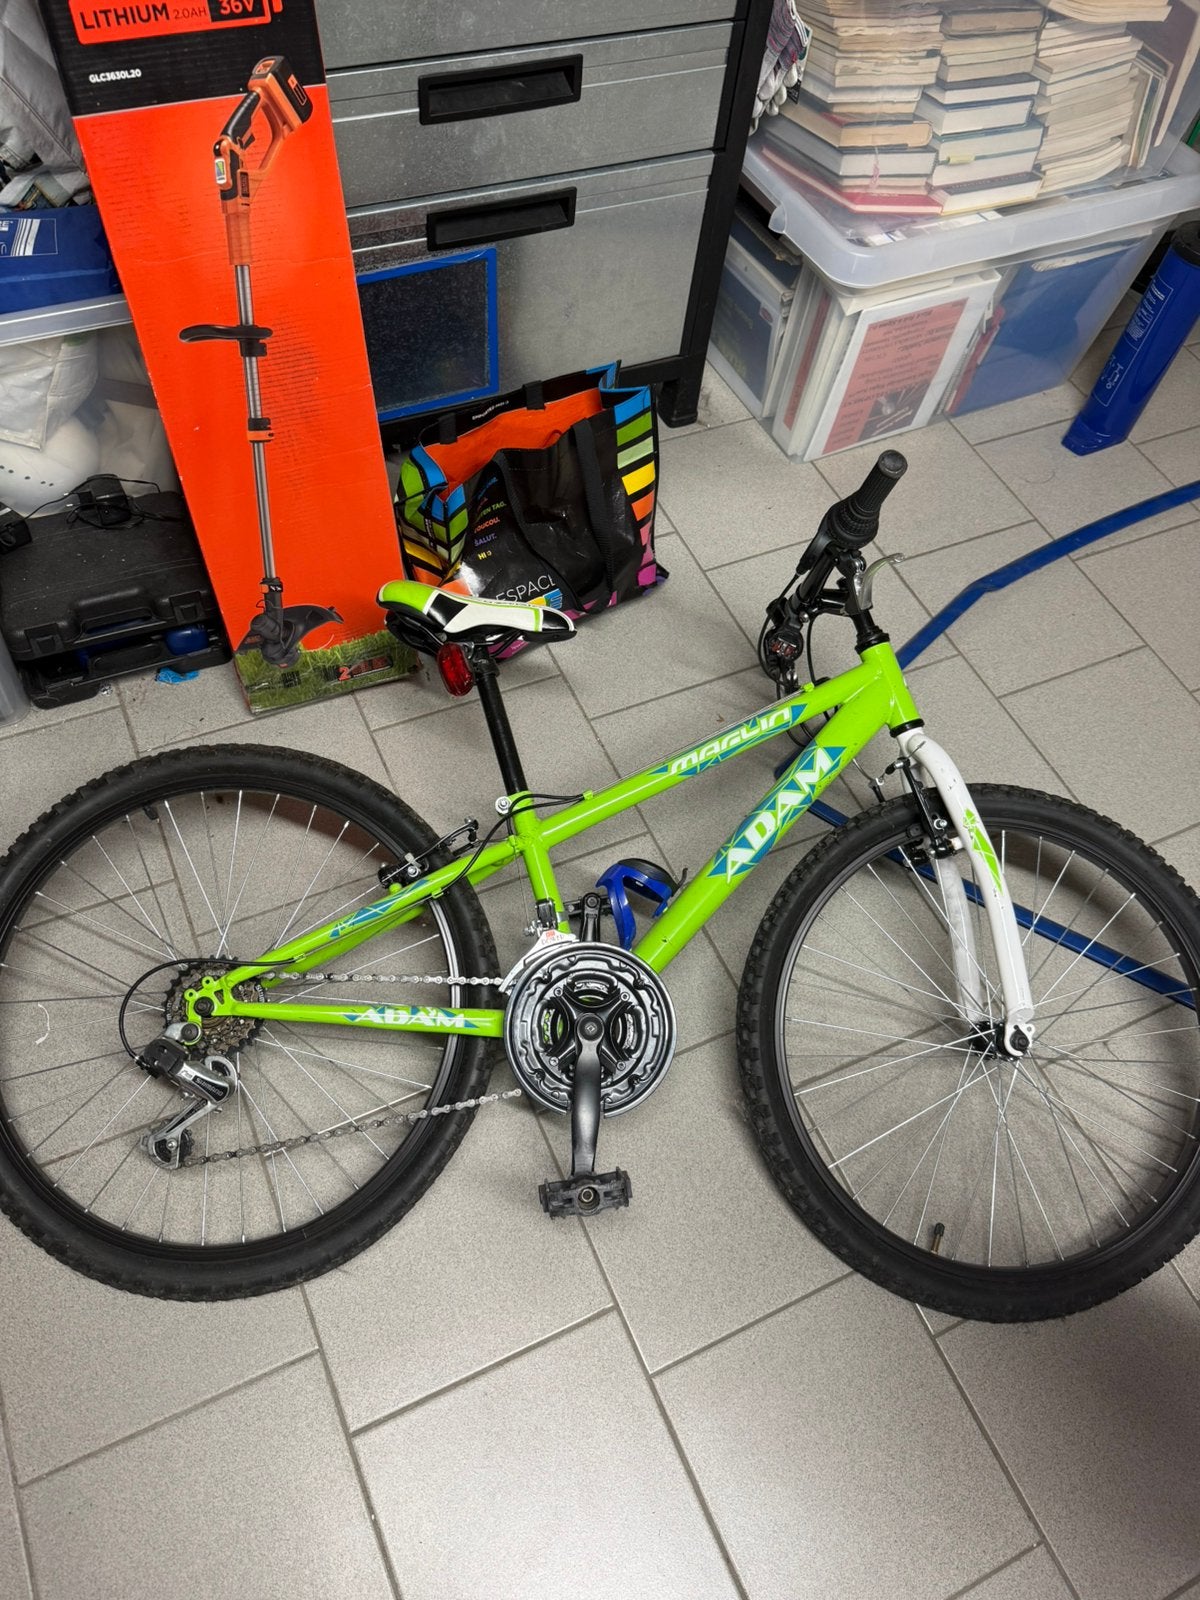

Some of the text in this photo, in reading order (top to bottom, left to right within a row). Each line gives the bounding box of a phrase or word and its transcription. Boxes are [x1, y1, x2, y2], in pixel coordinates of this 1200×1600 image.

[80, 0, 255, 30] LITHIUM 2.0AH 36V
[89, 68, 142, 83] GLC3630L20
[474, 533, 497, 546] SALUT.
[727, 747, 832, 884] ADAM
[356, 1007, 465, 1028] ADAM
